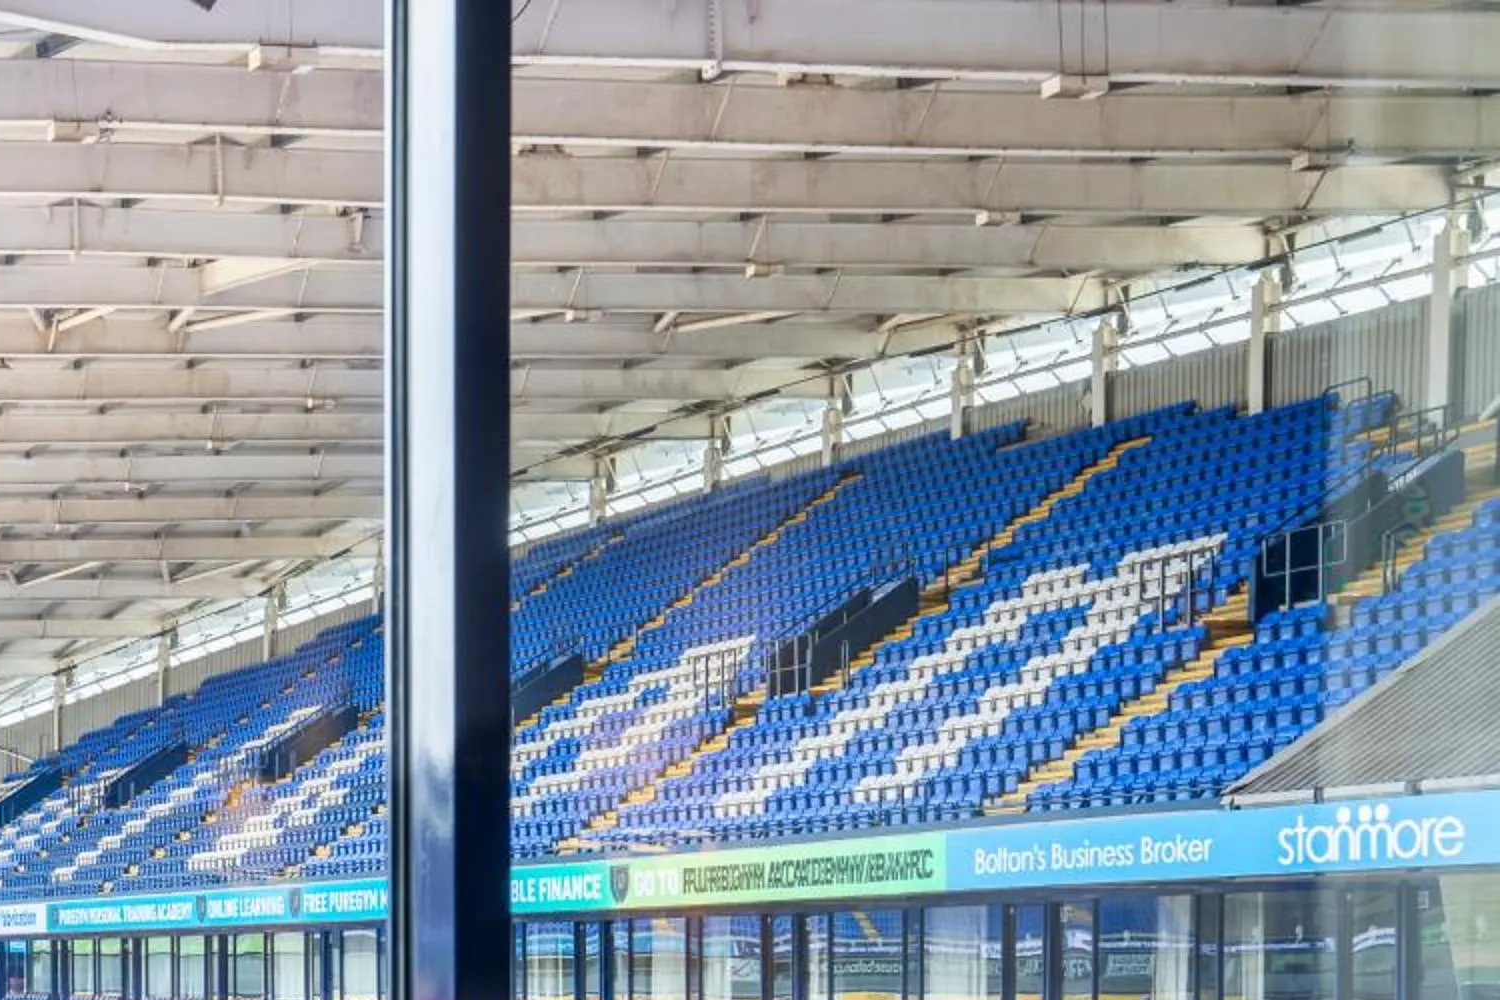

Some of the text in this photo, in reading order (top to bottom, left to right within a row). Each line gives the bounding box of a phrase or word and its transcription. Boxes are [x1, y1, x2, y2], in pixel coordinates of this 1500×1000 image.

[1278, 803, 1465, 865] stanmore
[975, 834, 1212, 875] Bolton's Business Broker
[538, 874, 603, 902] FINANCE
[634, 871, 656, 896] GO
[658, 869, 679, 894] TO
[240, 896, 284, 916] LEARNING
[304, 893, 328, 913] FREE
[329, 888, 378, 912] PUREGYM
